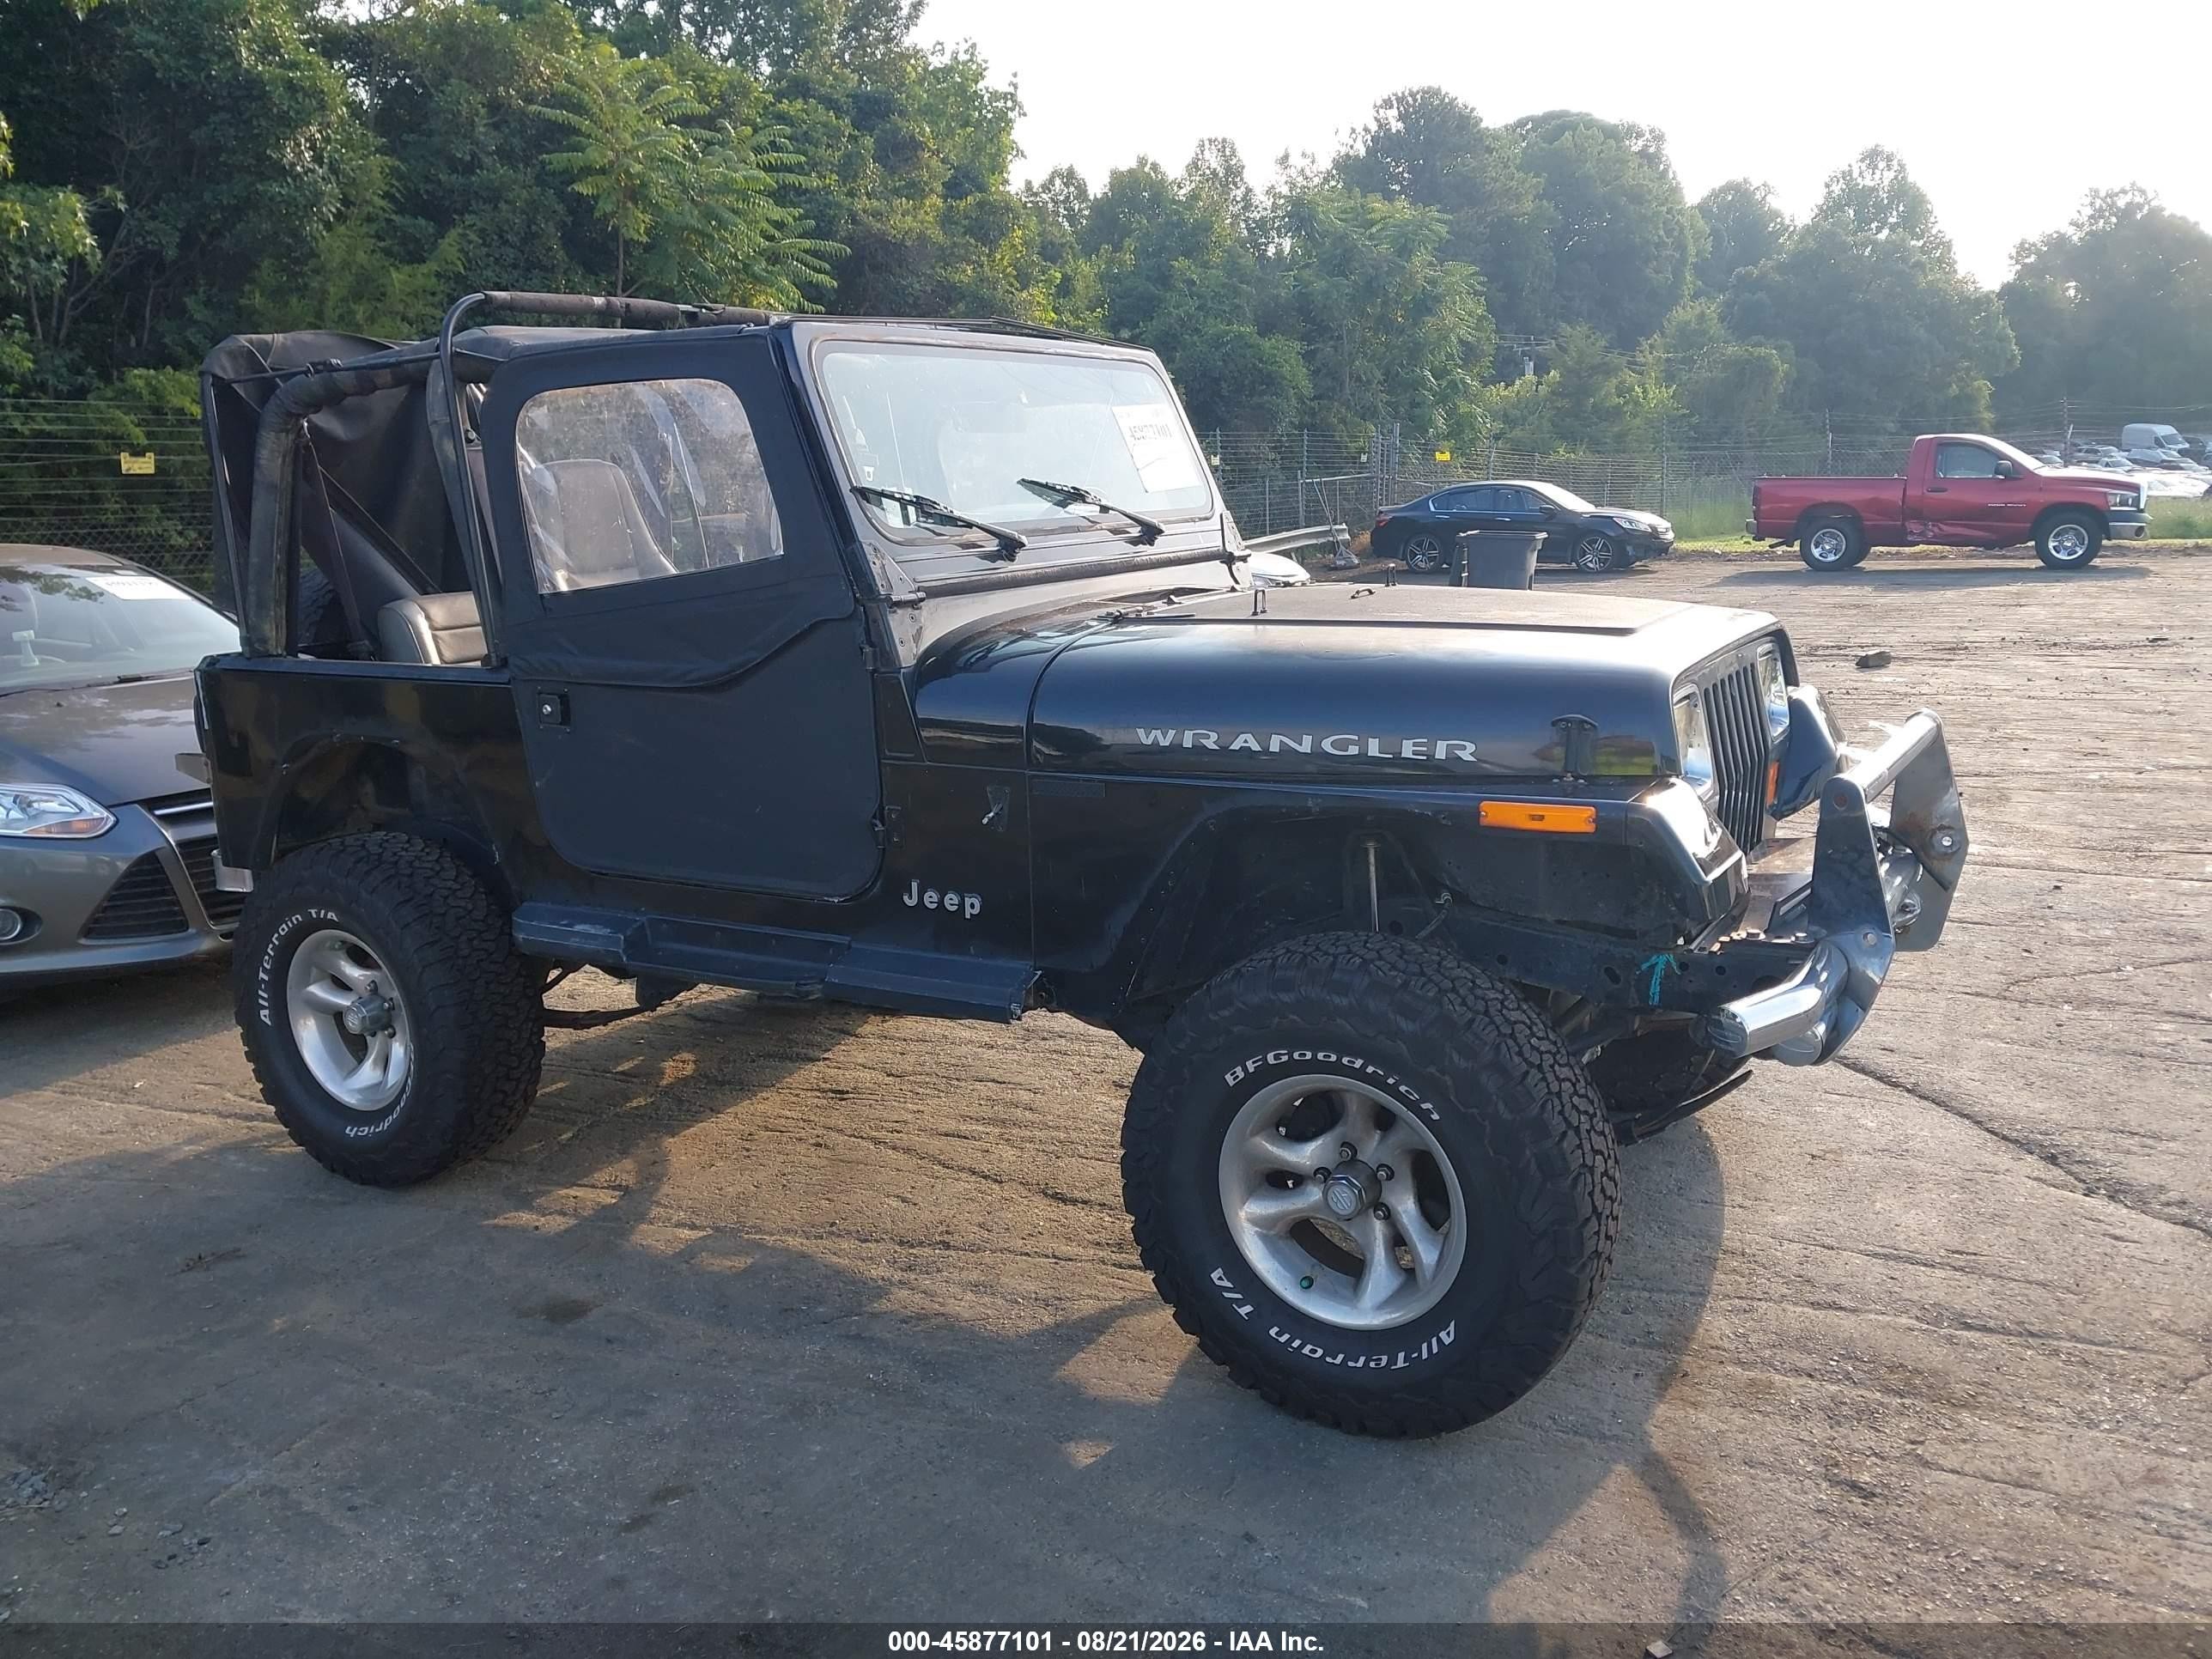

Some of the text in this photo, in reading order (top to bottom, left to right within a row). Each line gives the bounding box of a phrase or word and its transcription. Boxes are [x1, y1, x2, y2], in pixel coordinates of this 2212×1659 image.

[1135, 727, 1478, 763] WRANGLER
[902, 879, 983, 920] Jeep
[257, 908, 340, 1026] All-Terrain T/A
[1224, 1049, 1443, 1121] BFGoodrich
[1210, 1267, 1456, 1370] All-Terrain T/A
